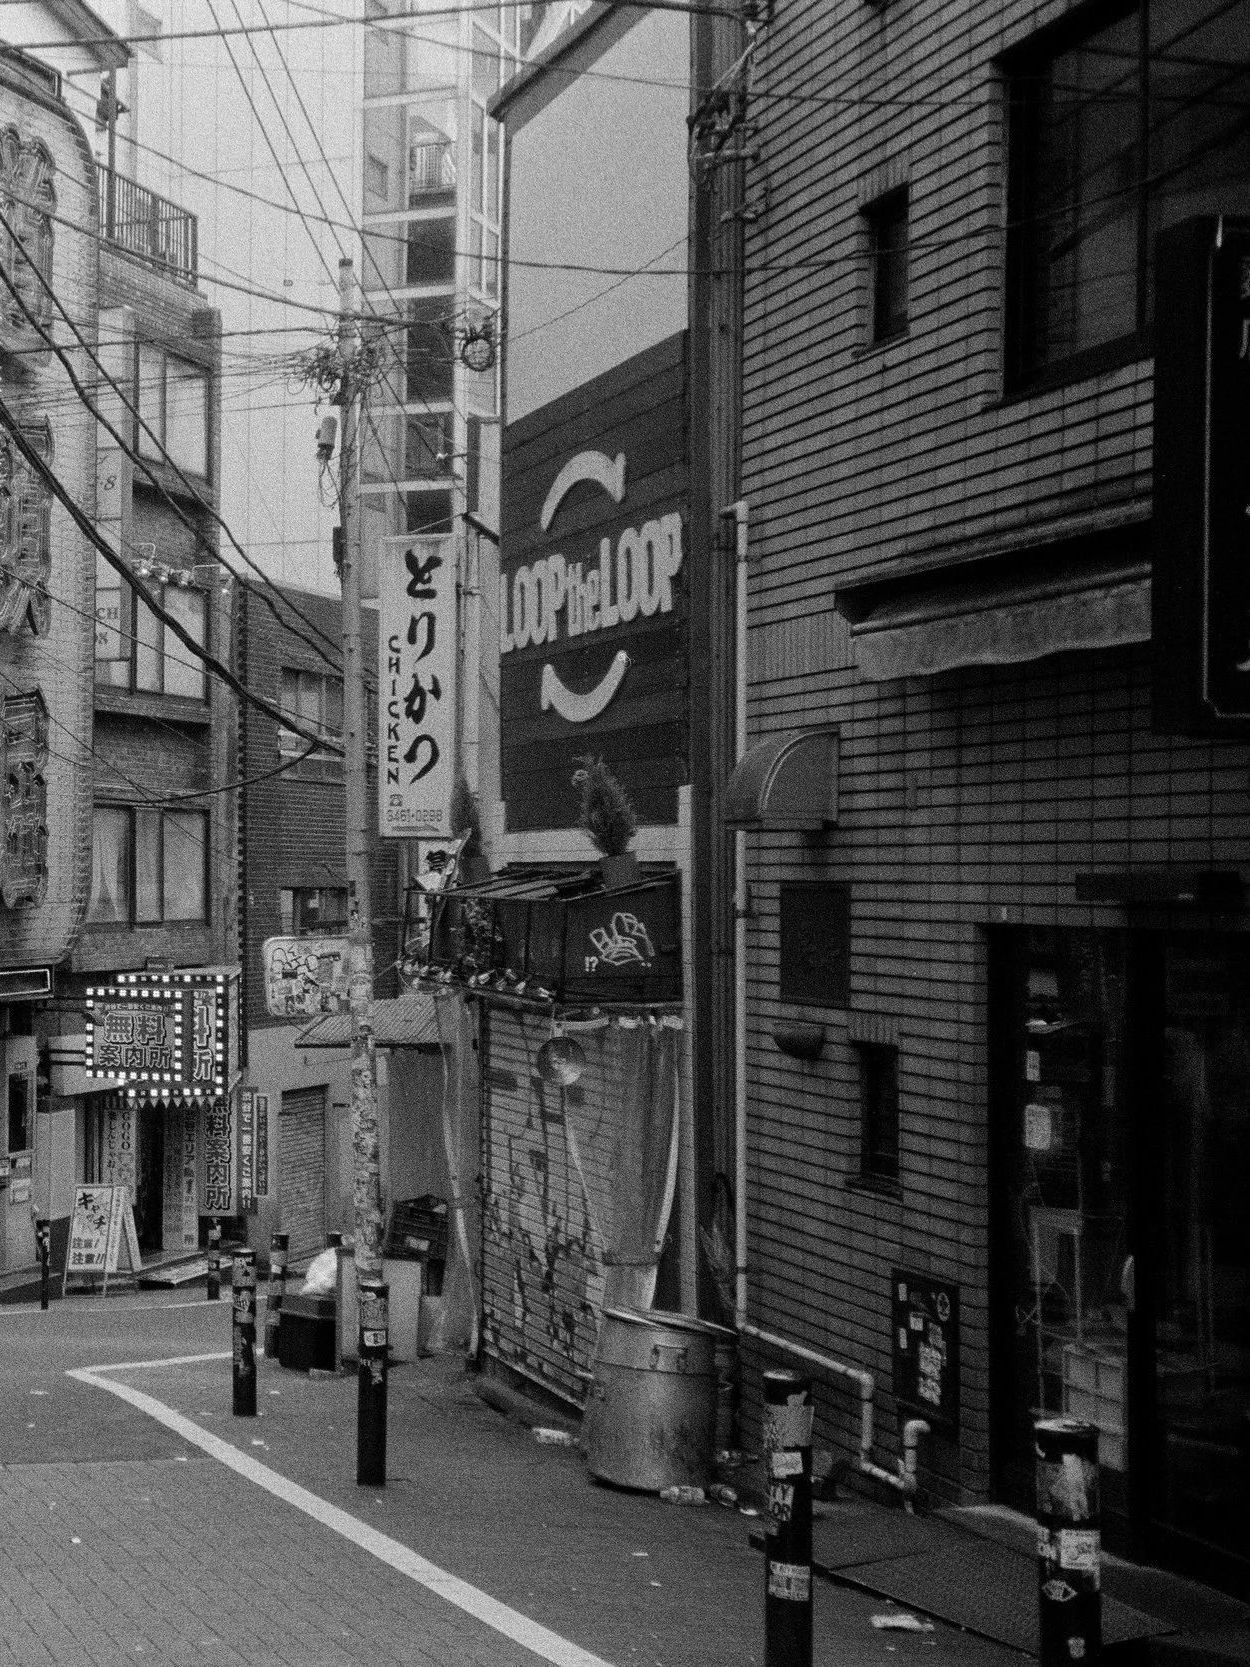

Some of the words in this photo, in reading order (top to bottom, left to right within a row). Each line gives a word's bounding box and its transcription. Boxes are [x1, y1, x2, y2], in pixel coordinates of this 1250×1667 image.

[500, 553, 566, 654] LOOP
[600, 511, 682, 629] LOOP
[387, 634, 401, 785] CHICKEN
[404, 549, 443, 785] とりかつ
[100, 1045, 172, 1069] 案内所
[104, 1012, 167, 1044] 無料
